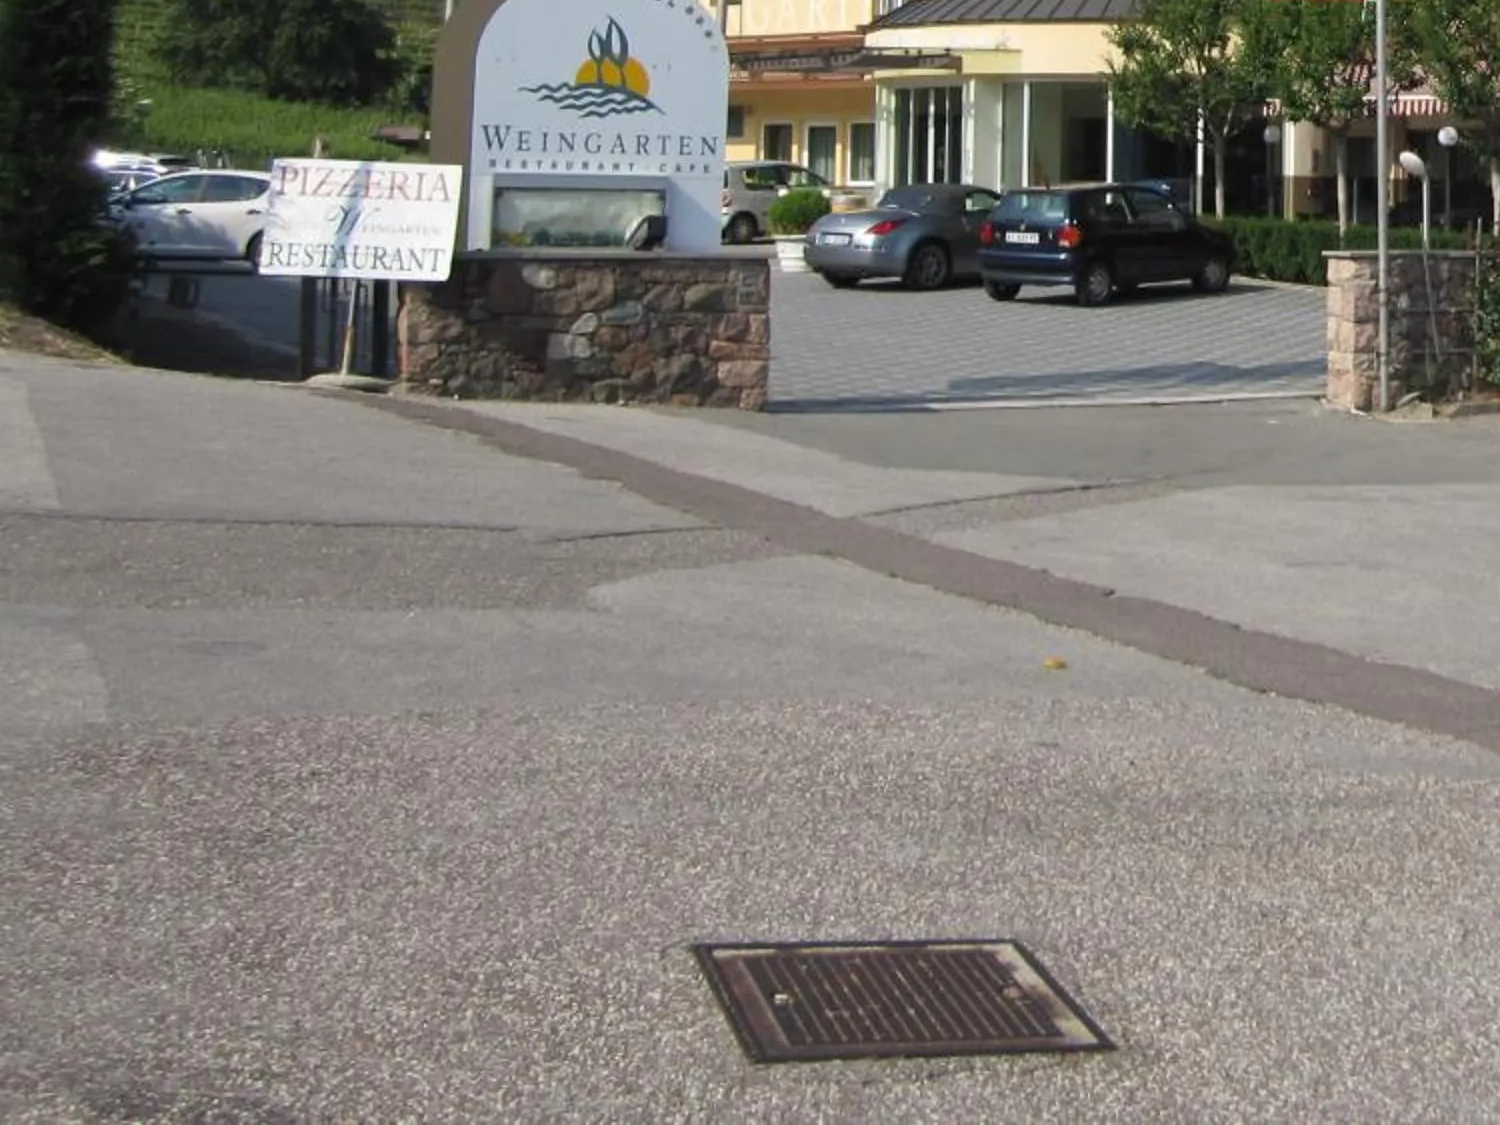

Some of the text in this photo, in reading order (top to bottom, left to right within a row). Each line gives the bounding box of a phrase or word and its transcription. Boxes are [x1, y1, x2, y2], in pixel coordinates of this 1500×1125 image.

[482, 125, 718, 156] WEINGARTEN
[489, 158, 634, 172] RESTAURANT
[278, 166, 451, 202] PIZZERIA
[268, 242, 446, 272] RESTAURANT
